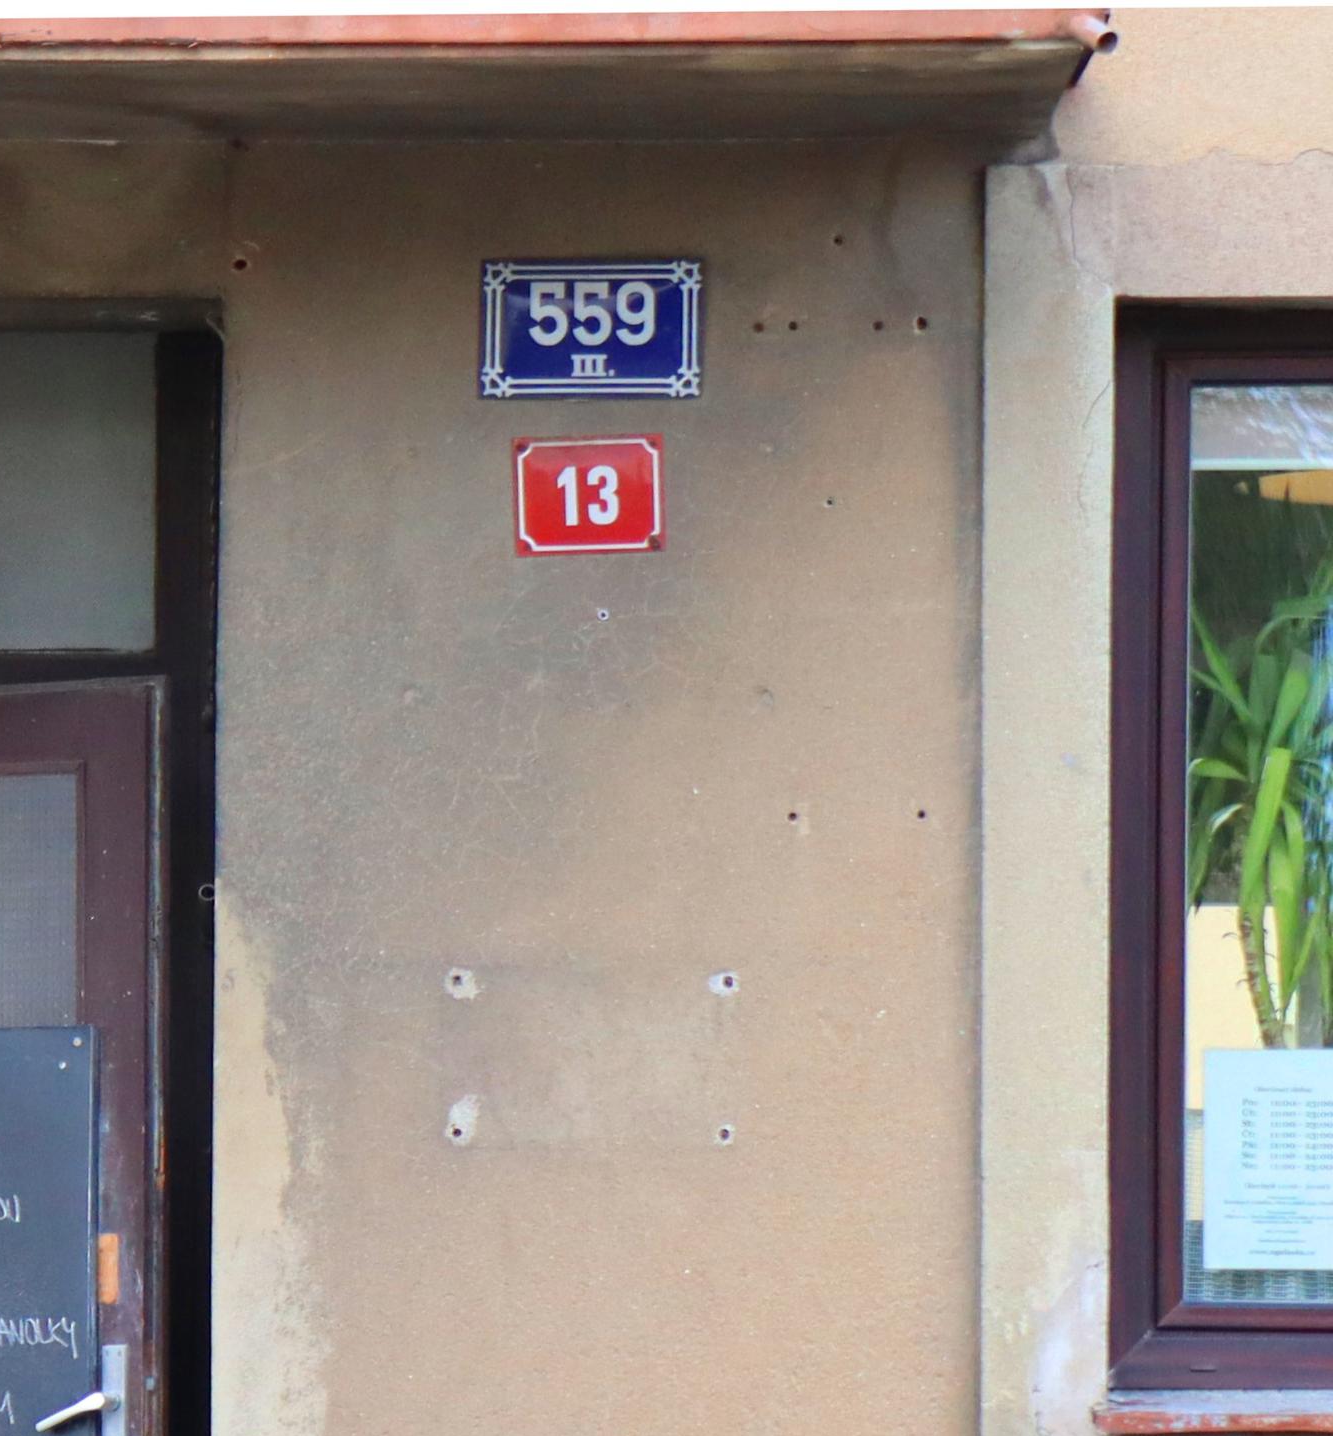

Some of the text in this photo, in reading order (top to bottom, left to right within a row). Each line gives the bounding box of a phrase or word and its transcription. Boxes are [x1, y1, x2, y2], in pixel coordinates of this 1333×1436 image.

[528, 280, 656, 347] 559
[570, 353, 615, 378] III.
[556, 464, 620, 527] 13
